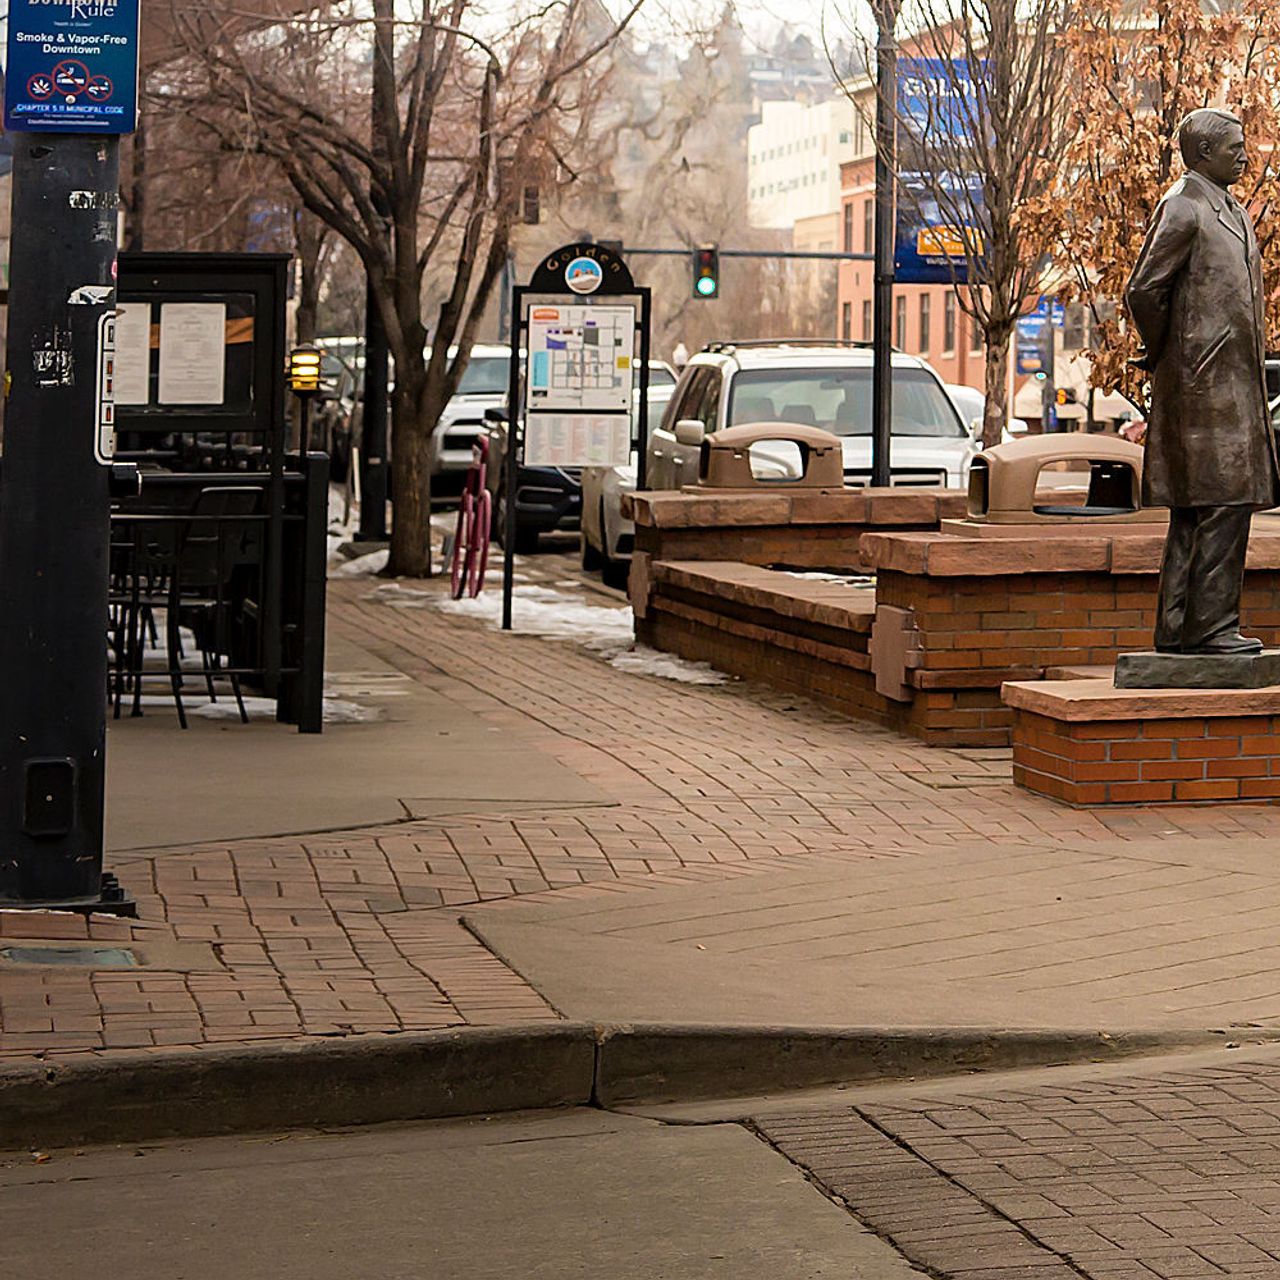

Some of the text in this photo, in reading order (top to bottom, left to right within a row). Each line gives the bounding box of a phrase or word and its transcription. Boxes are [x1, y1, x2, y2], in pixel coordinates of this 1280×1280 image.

[16, 31, 128, 46] Smoke & Vapor-Free
[42, 43, 101, 55] Downtown
[546, 247, 621, 273] Golden
